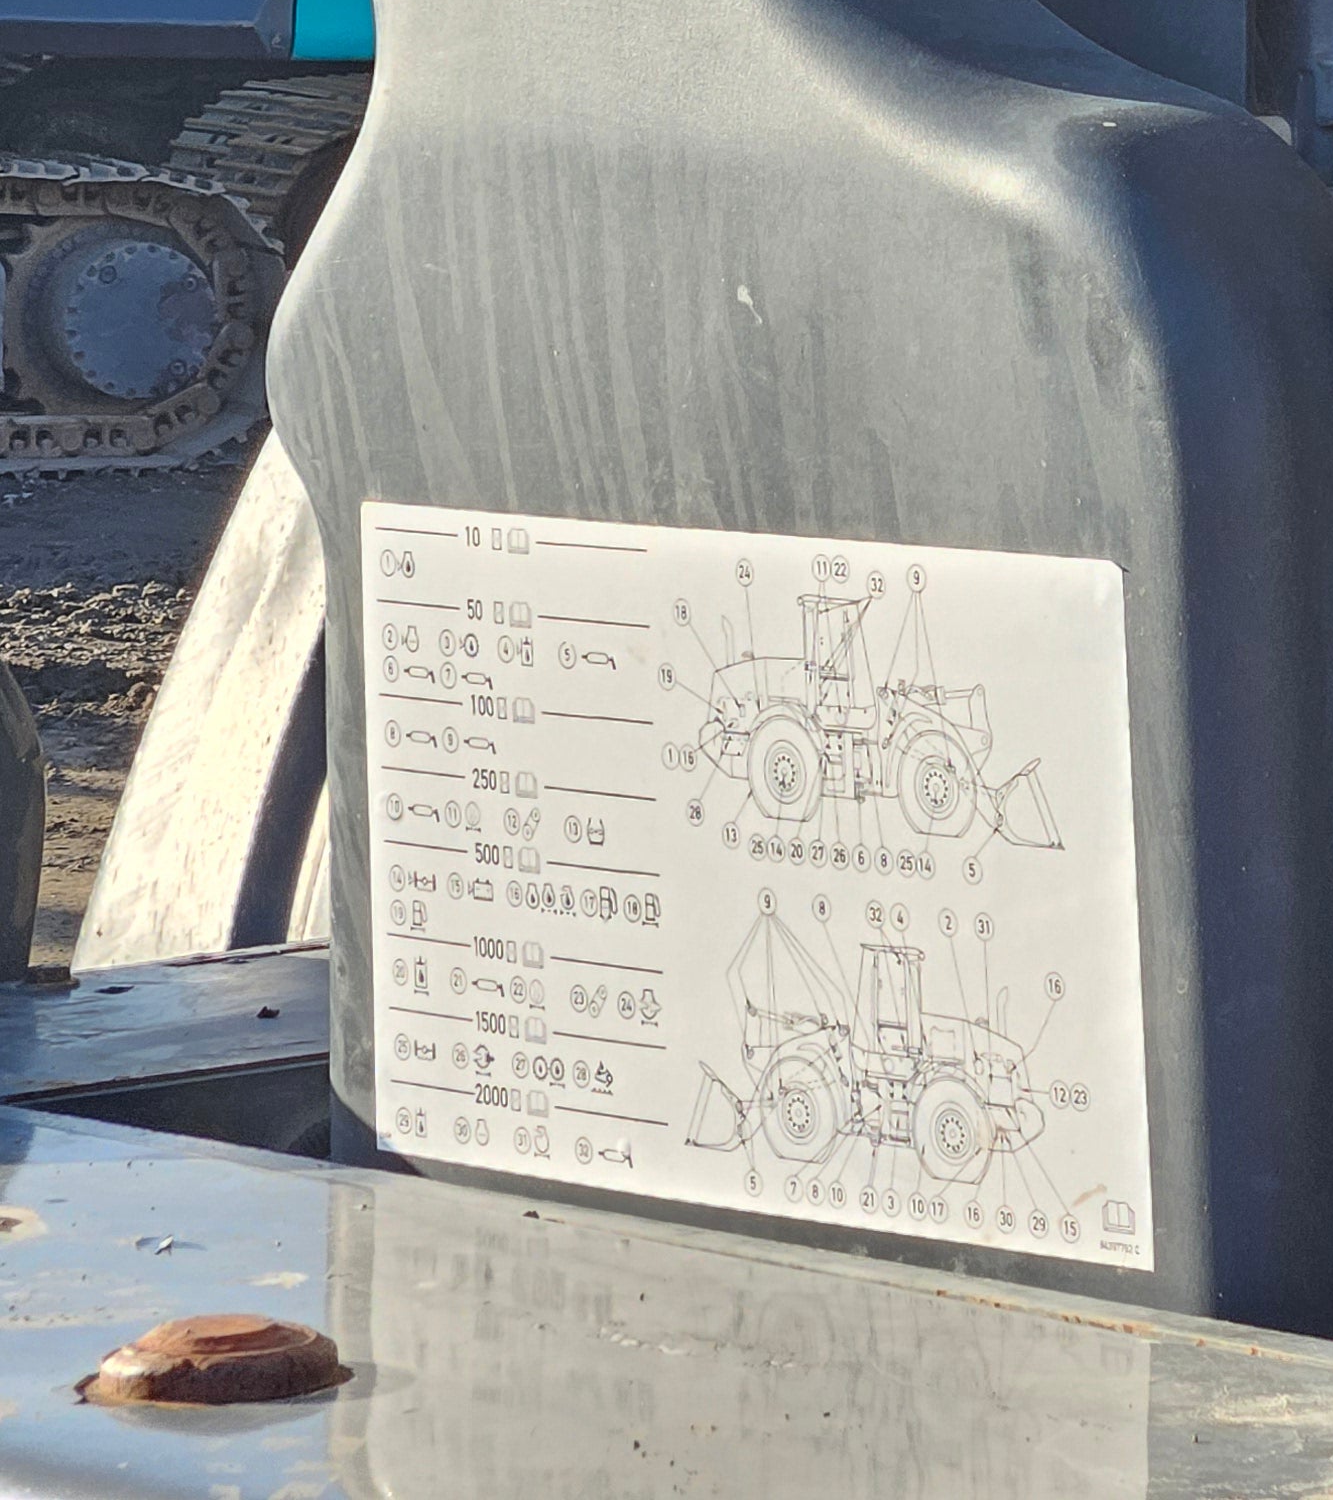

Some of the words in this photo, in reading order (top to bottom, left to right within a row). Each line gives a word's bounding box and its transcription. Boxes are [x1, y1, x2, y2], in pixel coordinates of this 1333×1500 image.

[464, 525, 481, 548] 10
[738, 564, 752, 580] 24
[815, 560, 828, 576] 11
[834, 561, 848, 578] 22
[870, 576, 884, 593] 32
[912, 570, 921, 586] 9
[466, 599, 484, 621] 50
[674, 604, 687, 620] 18
[386, 629, 394, 643] 2
[443, 635, 450, 650] 3
[502, 641, 510, 656] 4
[563, 647, 571, 662] 5
[445, 668, 452, 682] 7
[660, 668, 674, 684] 19
[470, 694, 495, 717] 100
[681, 749, 695, 766] 16
[472, 767, 498, 791] 250
[390, 800, 400, 814] 10
[448, 807, 458, 822] 11
[506, 814, 518, 829] 12
[568, 822, 578, 837] 13
[688, 804, 702, 820] 28
[724, 828, 738, 844] 13
[474, 842, 500, 865] 500
[750, 839, 764, 856] 25
[769, 842, 783, 858] 14
[790, 843, 804, 859] 20
[811, 845, 825, 862] 27
[832, 848, 846, 864] 26
[857, 850, 866, 866] 6
[880, 852, 888, 868] 8
[899, 855, 914, 872] 25
[918, 856, 932, 873] 14
[968, 862, 976, 878] 5
[583, 895, 595, 910] 17
[626, 901, 638, 916] 18
[763, 893, 772, 910] 9
[818, 899, 826, 916] 8
[869, 906, 883, 923] 32
[896, 910, 904, 925] 4
[944, 915, 952, 931] 2
[978, 918, 991, 934] 31
[472, 936, 504, 960] 1000
[452, 973, 464, 988] 21
[512, 982, 524, 997] 22
[573, 990, 585, 1006] 23
[620, 997, 632, 1013] 24
[1048, 978, 1062, 995] 16
[475, 1010, 507, 1036] 1500
[514, 1058, 526, 1073] 27
[474, 1082, 510, 1108] 2000
[1053, 1086, 1067, 1103] 12
[1073, 1088, 1088, 1105] 23
[516, 1132, 528, 1148] 31
[748, 1176, 758, 1191] 5
[790, 1180, 798, 1196] 7
[811, 1184, 820, 1199] 8
[831, 1188, 844, 1203] 10
[862, 1192, 876, 1208] 21
[887, 1196, 896, 1210] 3
[911, 1198, 925, 1215] 10
[930, 1202, 945, 1218] 17
[966, 1206, 981, 1222] 16
[998, 1211, 1013, 1228] 30
[1032, 1216, 1047, 1232] 29
[1064, 1220, 1078, 1237] 15
